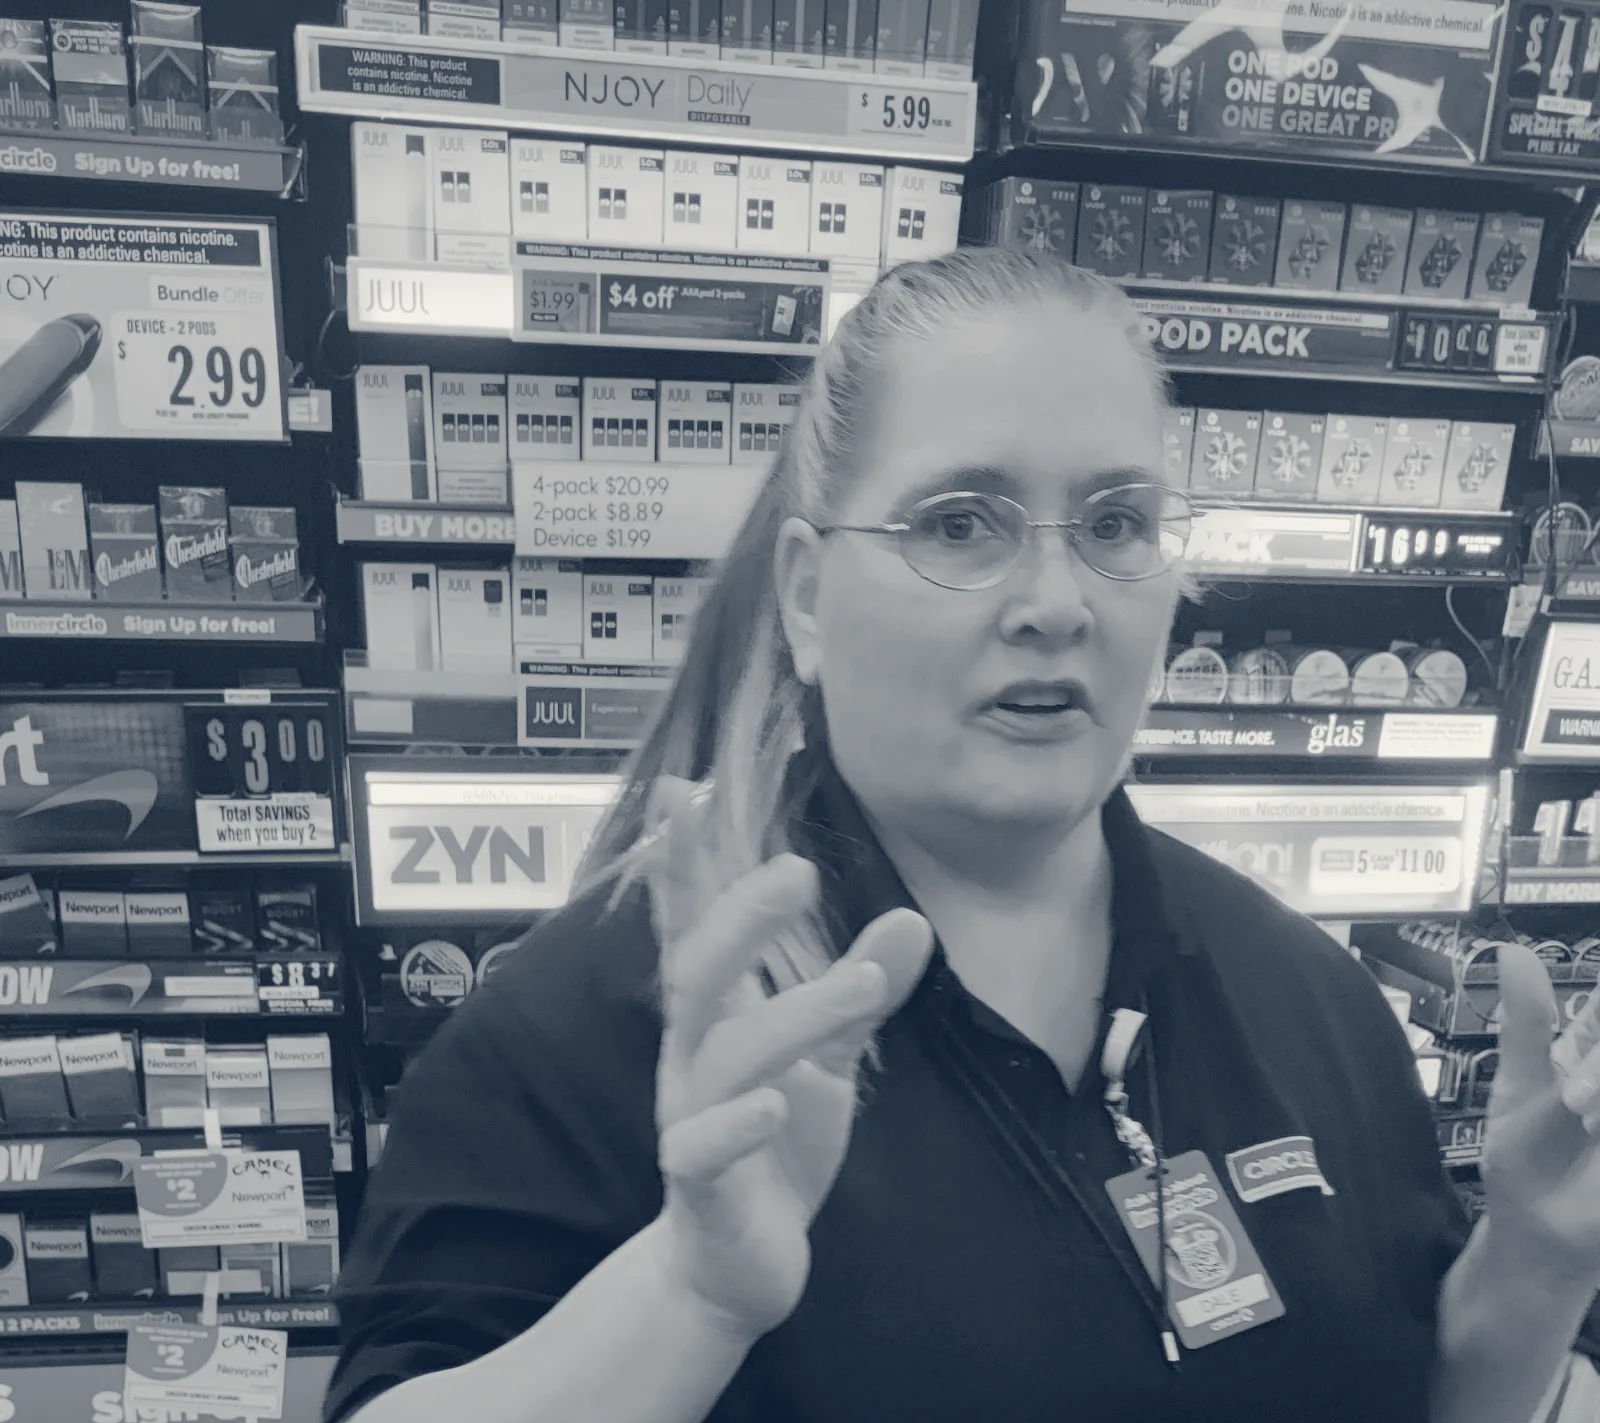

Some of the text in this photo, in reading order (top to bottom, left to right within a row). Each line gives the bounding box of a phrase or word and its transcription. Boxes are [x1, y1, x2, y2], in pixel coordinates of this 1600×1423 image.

[1358, 9, 1485, 32] is an addictive chemical.
[352, 50, 466, 72] WARNING: This product
[348, 66, 472, 86] contains nicotine. Nicotine
[353, 80, 468, 100] is an addictive chemical.
[565, 70, 750, 112] NJOY Daily
[1225, 78, 1373, 110] ONE DEVICE
[64, 98, 126, 129] Marlboro
[883, 95, 931, 129] 5.99
[1222, 105, 1361, 137] ONE GREAT
[362, 131, 389, 147] JUUL
[439, 136, 465, 152] JUUL
[518, 147, 544, 162] JUUL
[598, 153, 623, 169] JUUL
[75, 153, 121, 174] Sign
[125, 156, 154, 176] Up
[158, 158, 189, 177] for
[192, 161, 240, 181] free!
[674, 159, 698, 174] JUUL
[747, 165, 771, 181] JUUL
[820, 169, 844, 184] JUUL
[901, 175, 925, 191] JUUL
[27, 223, 238, 247] This product contains nicotine.
[42, 244, 210, 264] is an addictive chemical.
[157, 284, 219, 302] Bundle
[366, 278, 429, 315] JUUL
[530, 291, 575, 310] $1.99
[609, 282, 638, 308] $4
[127, 318, 216, 335] DEVICE 2 PODS
[1220, 322, 1310, 358] PACK
[117, 341, 266, 408] $ 2.99
[533, 476, 670, 499] 4-pack $20.99
[533, 501, 663, 524] 2-pack $8.89
[374, 515, 516, 541] BUY MORE
[533, 527, 651, 549] Device $1.99
[165, 526, 226, 568] Chesterfield
[98, 544, 157, 586] Chesterfield
[236, 548, 295, 588] Chesterfield
[124, 616, 274, 634] Sign Up for free!
[533, 701, 575, 725] JUUL
[1199, 730, 1233, 746] TASTE
[219, 805, 310, 821] Total SAVINGS
[1257, 802, 1307, 817] Nicotine
[1311, 804, 1319, 816] is
[1323, 807, 1337, 817] an
[1340, 804, 1391, 818] addictive
[216, 824, 316, 845] when you buy 2
[389, 825, 546, 884] ZYN
[1357, 849, 1368, 873] 5
[66, 902, 120, 916] Newport
[130, 904, 183, 917] Newport
[1, 1055, 52, 1067] Newport
[66, 1050, 118, 1065] Newport
[148, 1060, 197, 1071] Newport
[274, 1051, 324, 1063] Newport
[212, 1070, 262, 1082] Newport
[232, 1158, 294, 1177] CAMEL
[231, 1190, 287, 1204] Newport
[31, 1240, 82, 1252] Newport
[21, 1316, 80, 1331] PACKS
[238, 1311, 260, 1323] Up
[264, 1310, 289, 1321] for
[292, 1309, 328, 1321] free!
[222, 1334, 279, 1354] CAMEL
[217, 1363, 270, 1378] Newport
